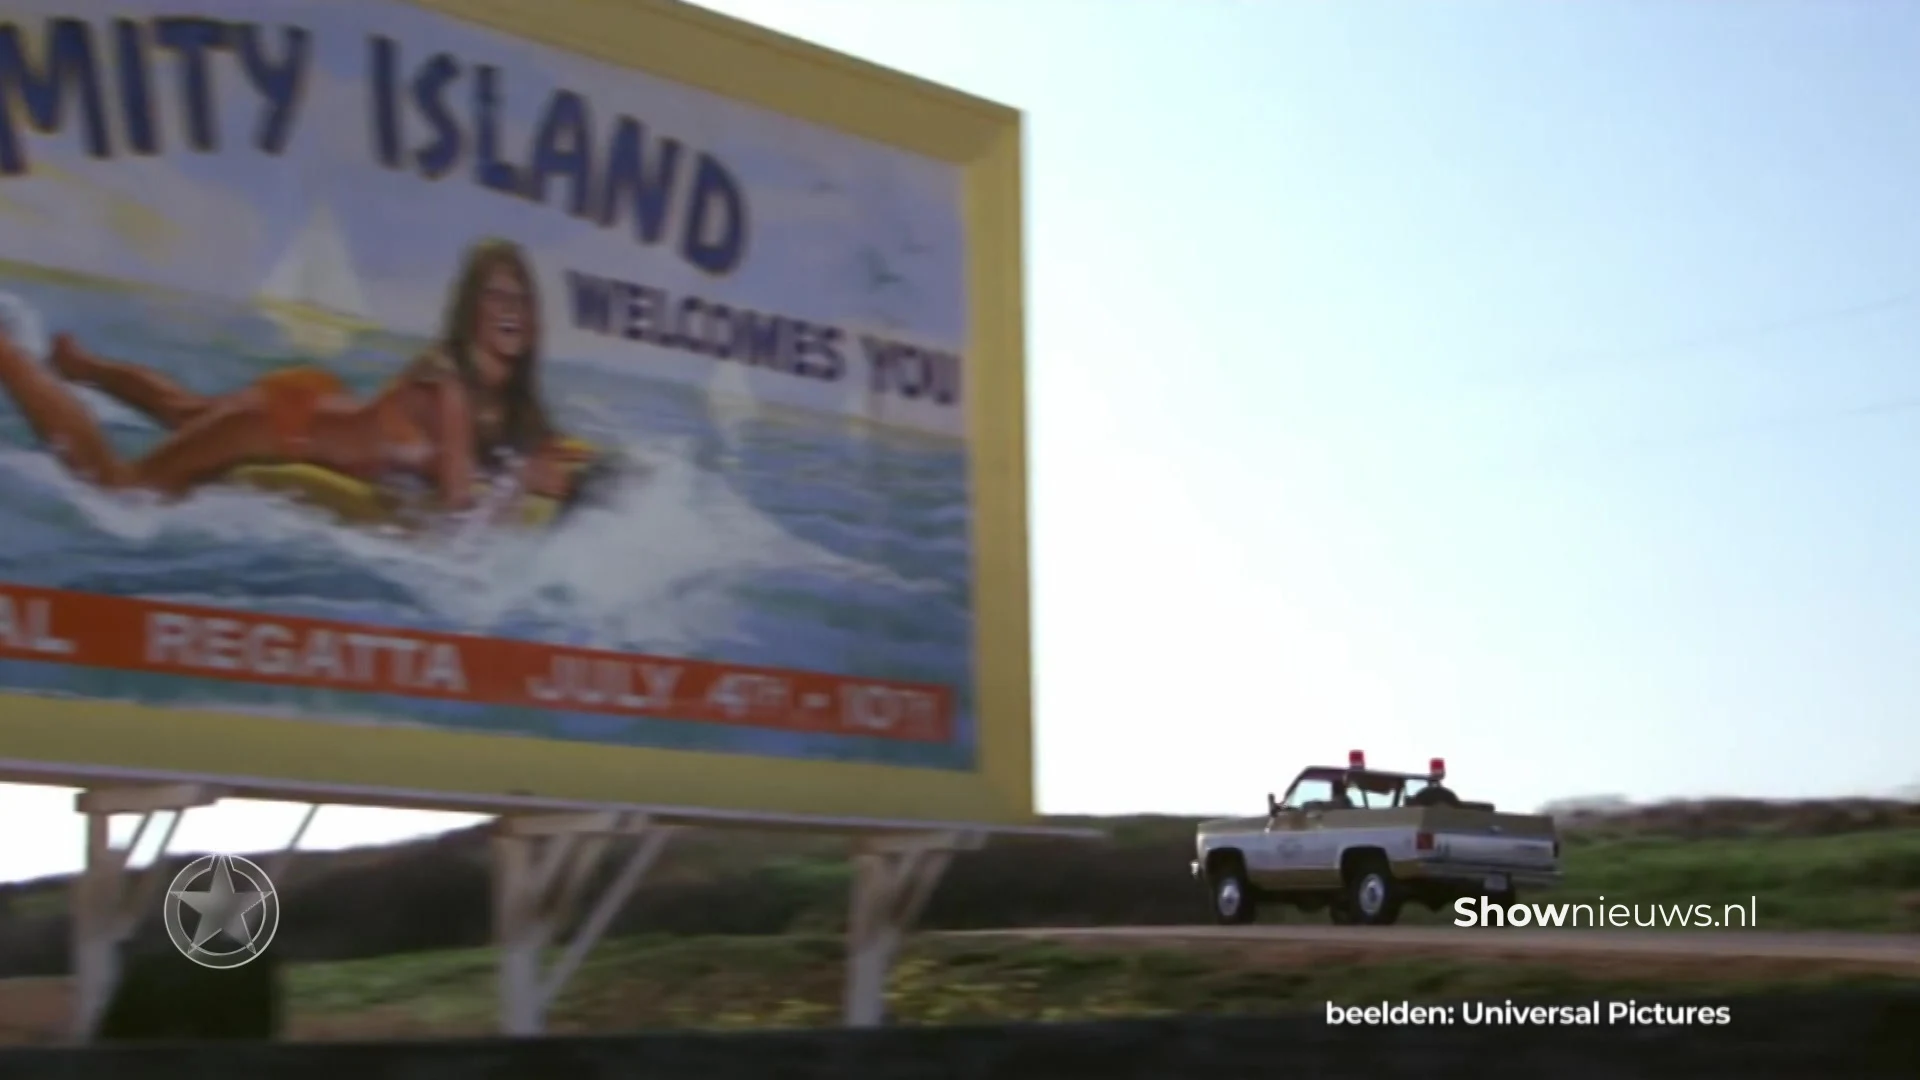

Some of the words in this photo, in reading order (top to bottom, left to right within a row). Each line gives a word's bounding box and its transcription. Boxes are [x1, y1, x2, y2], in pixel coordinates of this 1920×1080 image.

[366, 34, 747, 275] ISLAND
[564, 267, 846, 381] WELCOMES
[856, 332, 962, 405] YOU
[143, 608, 470, 694] REGATTA
[524, 653, 685, 710] JULY
